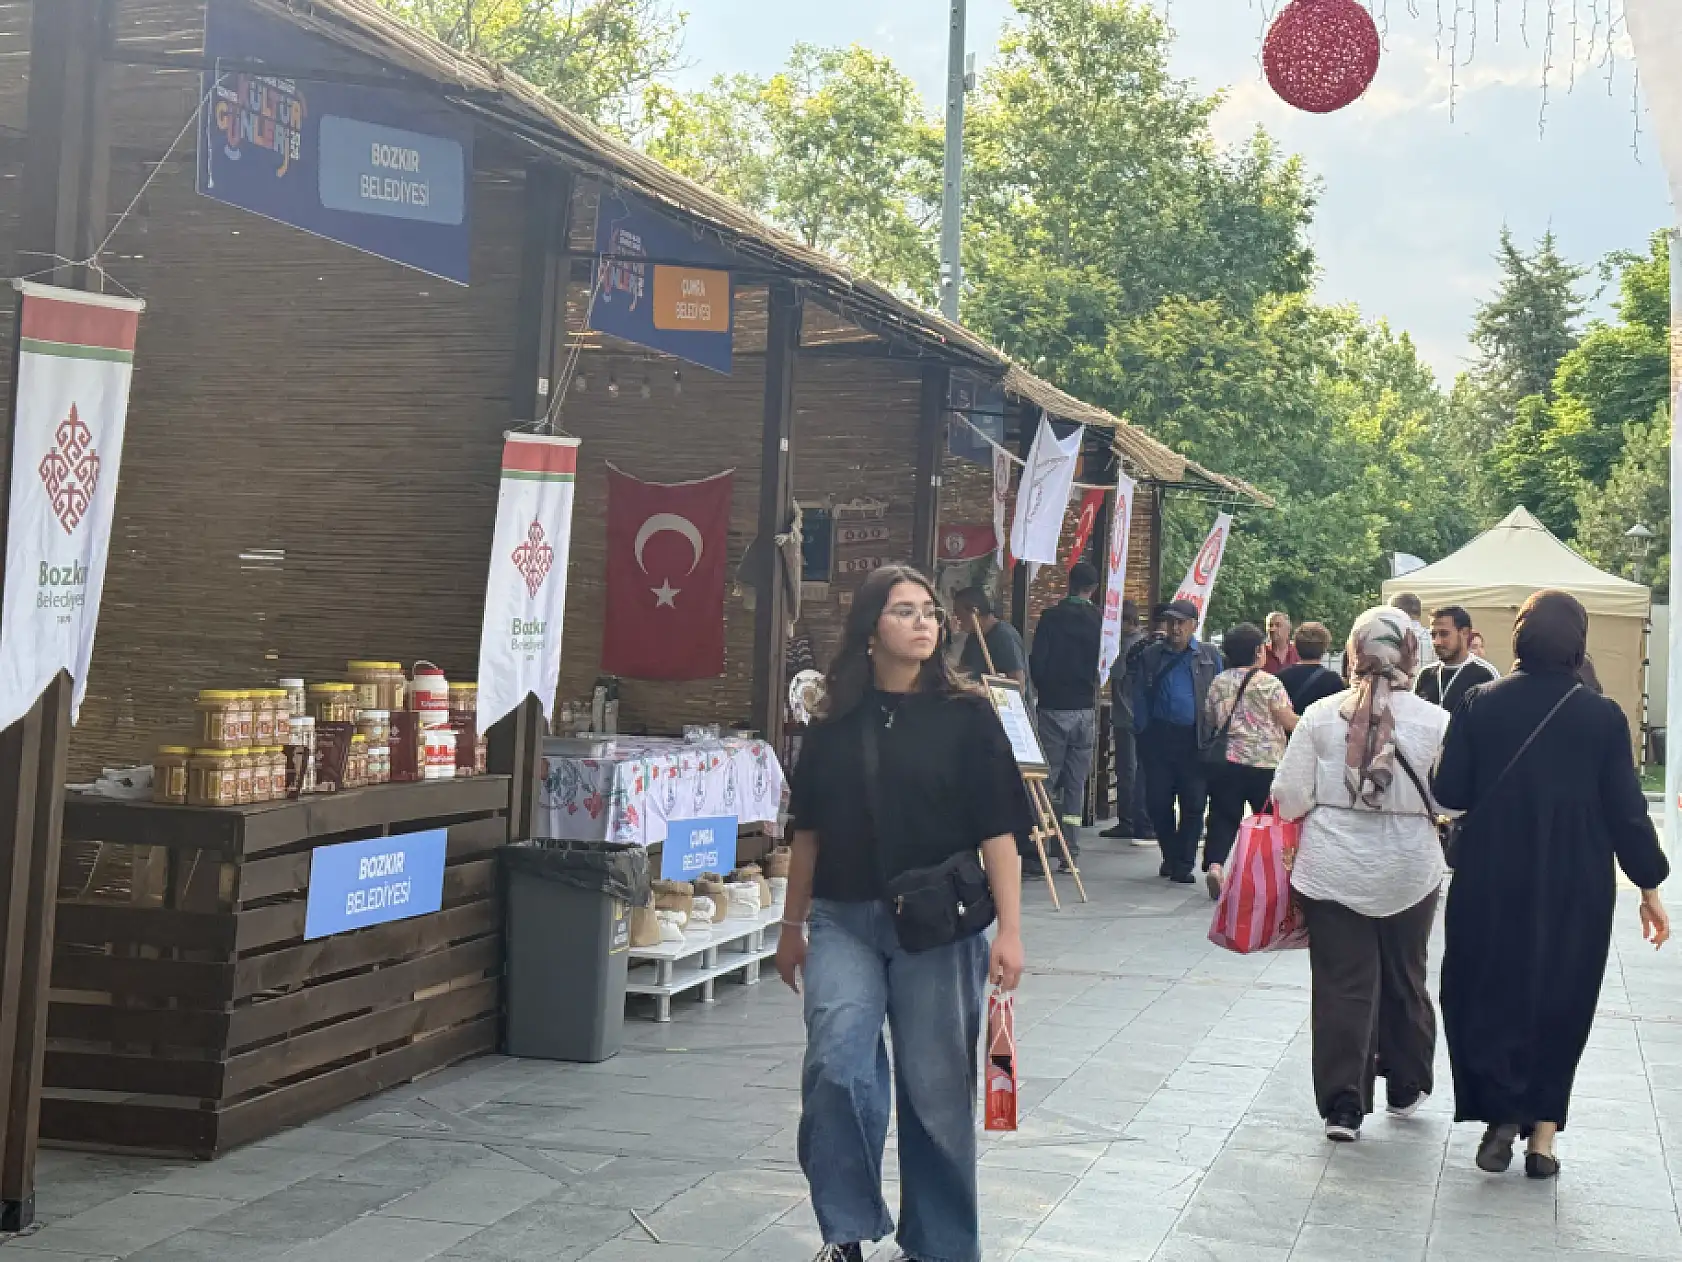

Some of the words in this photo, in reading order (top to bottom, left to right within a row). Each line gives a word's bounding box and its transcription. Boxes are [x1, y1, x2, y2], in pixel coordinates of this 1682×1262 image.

[370, 142, 421, 173] BOZKIR
[359, 174, 431, 207] BELEDİYESİ
[359, 851, 406, 880] BOZKIR
[345, 876, 412, 915] BELEDİYESİ
